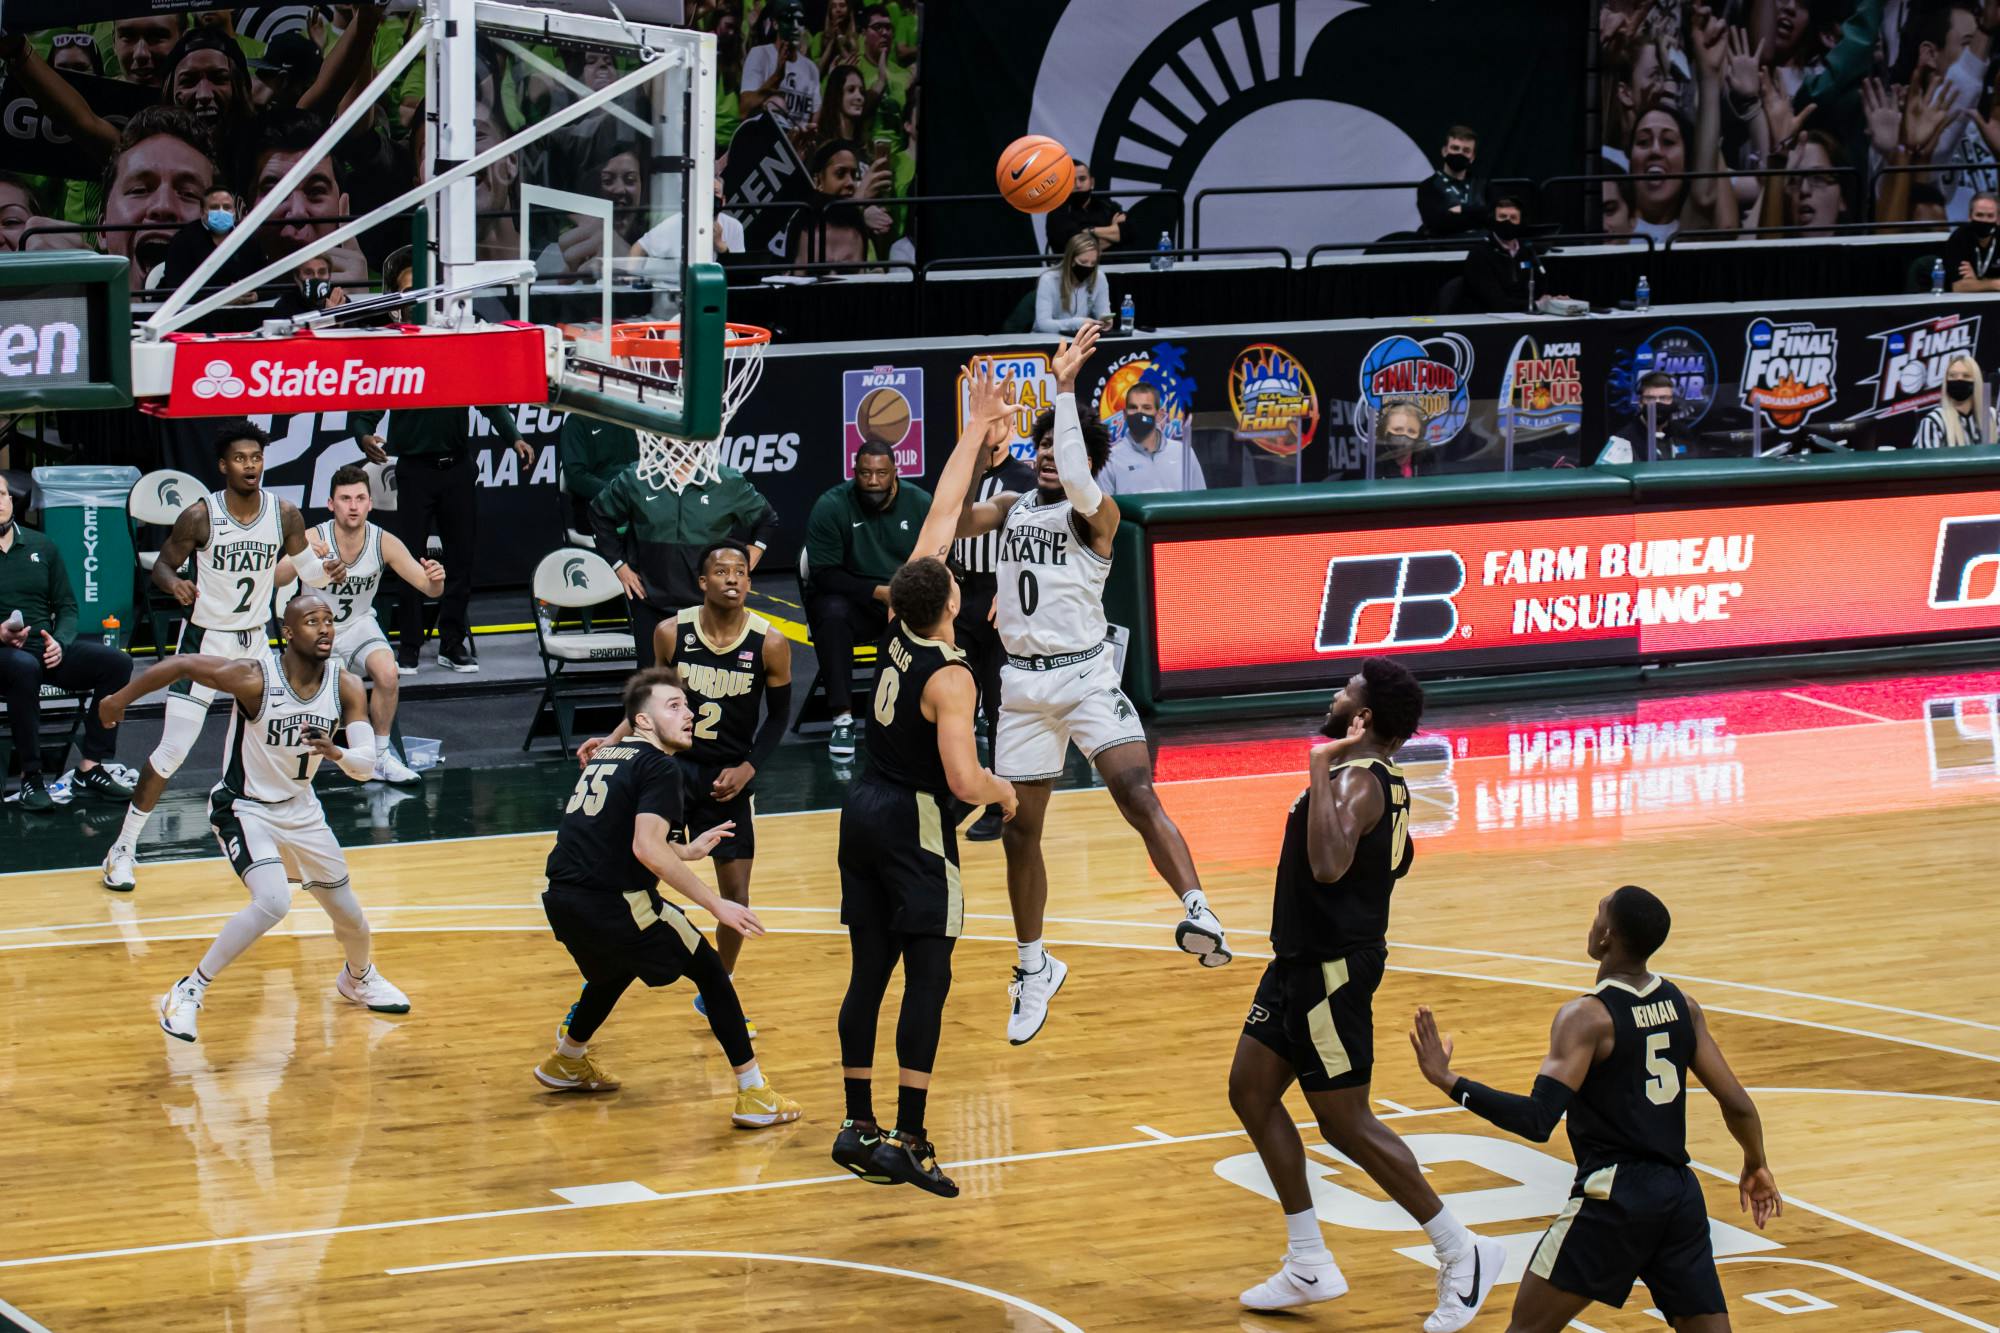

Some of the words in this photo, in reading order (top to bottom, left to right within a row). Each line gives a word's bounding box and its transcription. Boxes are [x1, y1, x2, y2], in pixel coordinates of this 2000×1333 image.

[0, 322, 81, 377] en
[1542, 342, 1582, 357] NCAA
[1771, 329, 1831, 357] FINAL
[1906, 324, 1971, 360] FINAL
[980, 361, 1036, 377] CAA
[1108, 351, 1150, 374] NCAA
[1373, 361, 1415, 394] FINAL
[1416, 359, 1457, 392] FOUR
[1514, 357, 1581, 388] FINAL
[1655, 352, 1705, 374] FINAL
[1745, 349, 1831, 391] FOUR
[862, 373, 906, 387] NCAA
[1091, 377, 1107, 409] 999
[1241, 413, 1293, 431] Four
[1256, 399, 1309, 417] Final
[893, 448, 918, 466] OUR
[212, 543, 277, 572] STATE
[217, 540, 266, 553] MICHIGAN
[1482, 545, 1589, 586] FARM
[1599, 533, 1755, 579] BUREAU
[232, 576, 255, 613] 2
[322, 572, 377, 596] TATE
[1018, 569, 1039, 616] 0
[334, 598, 354, 623] 3
[1512, 582, 1733, 635] INSURANCE
[590, 647, 638, 658] SPARTANS
[677, 661, 755, 699] PURDUE
[873, 665, 900, 727] 0
[283, 714, 330, 729] MICHIGAN
[694, 701, 722, 740] 2
[291, 751, 310, 780] 1
[565, 763, 619, 816] 55
[228, 836, 241, 862] S
[1246, 1003, 1271, 1025] P
[1645, 1031, 1681, 1106] 5
